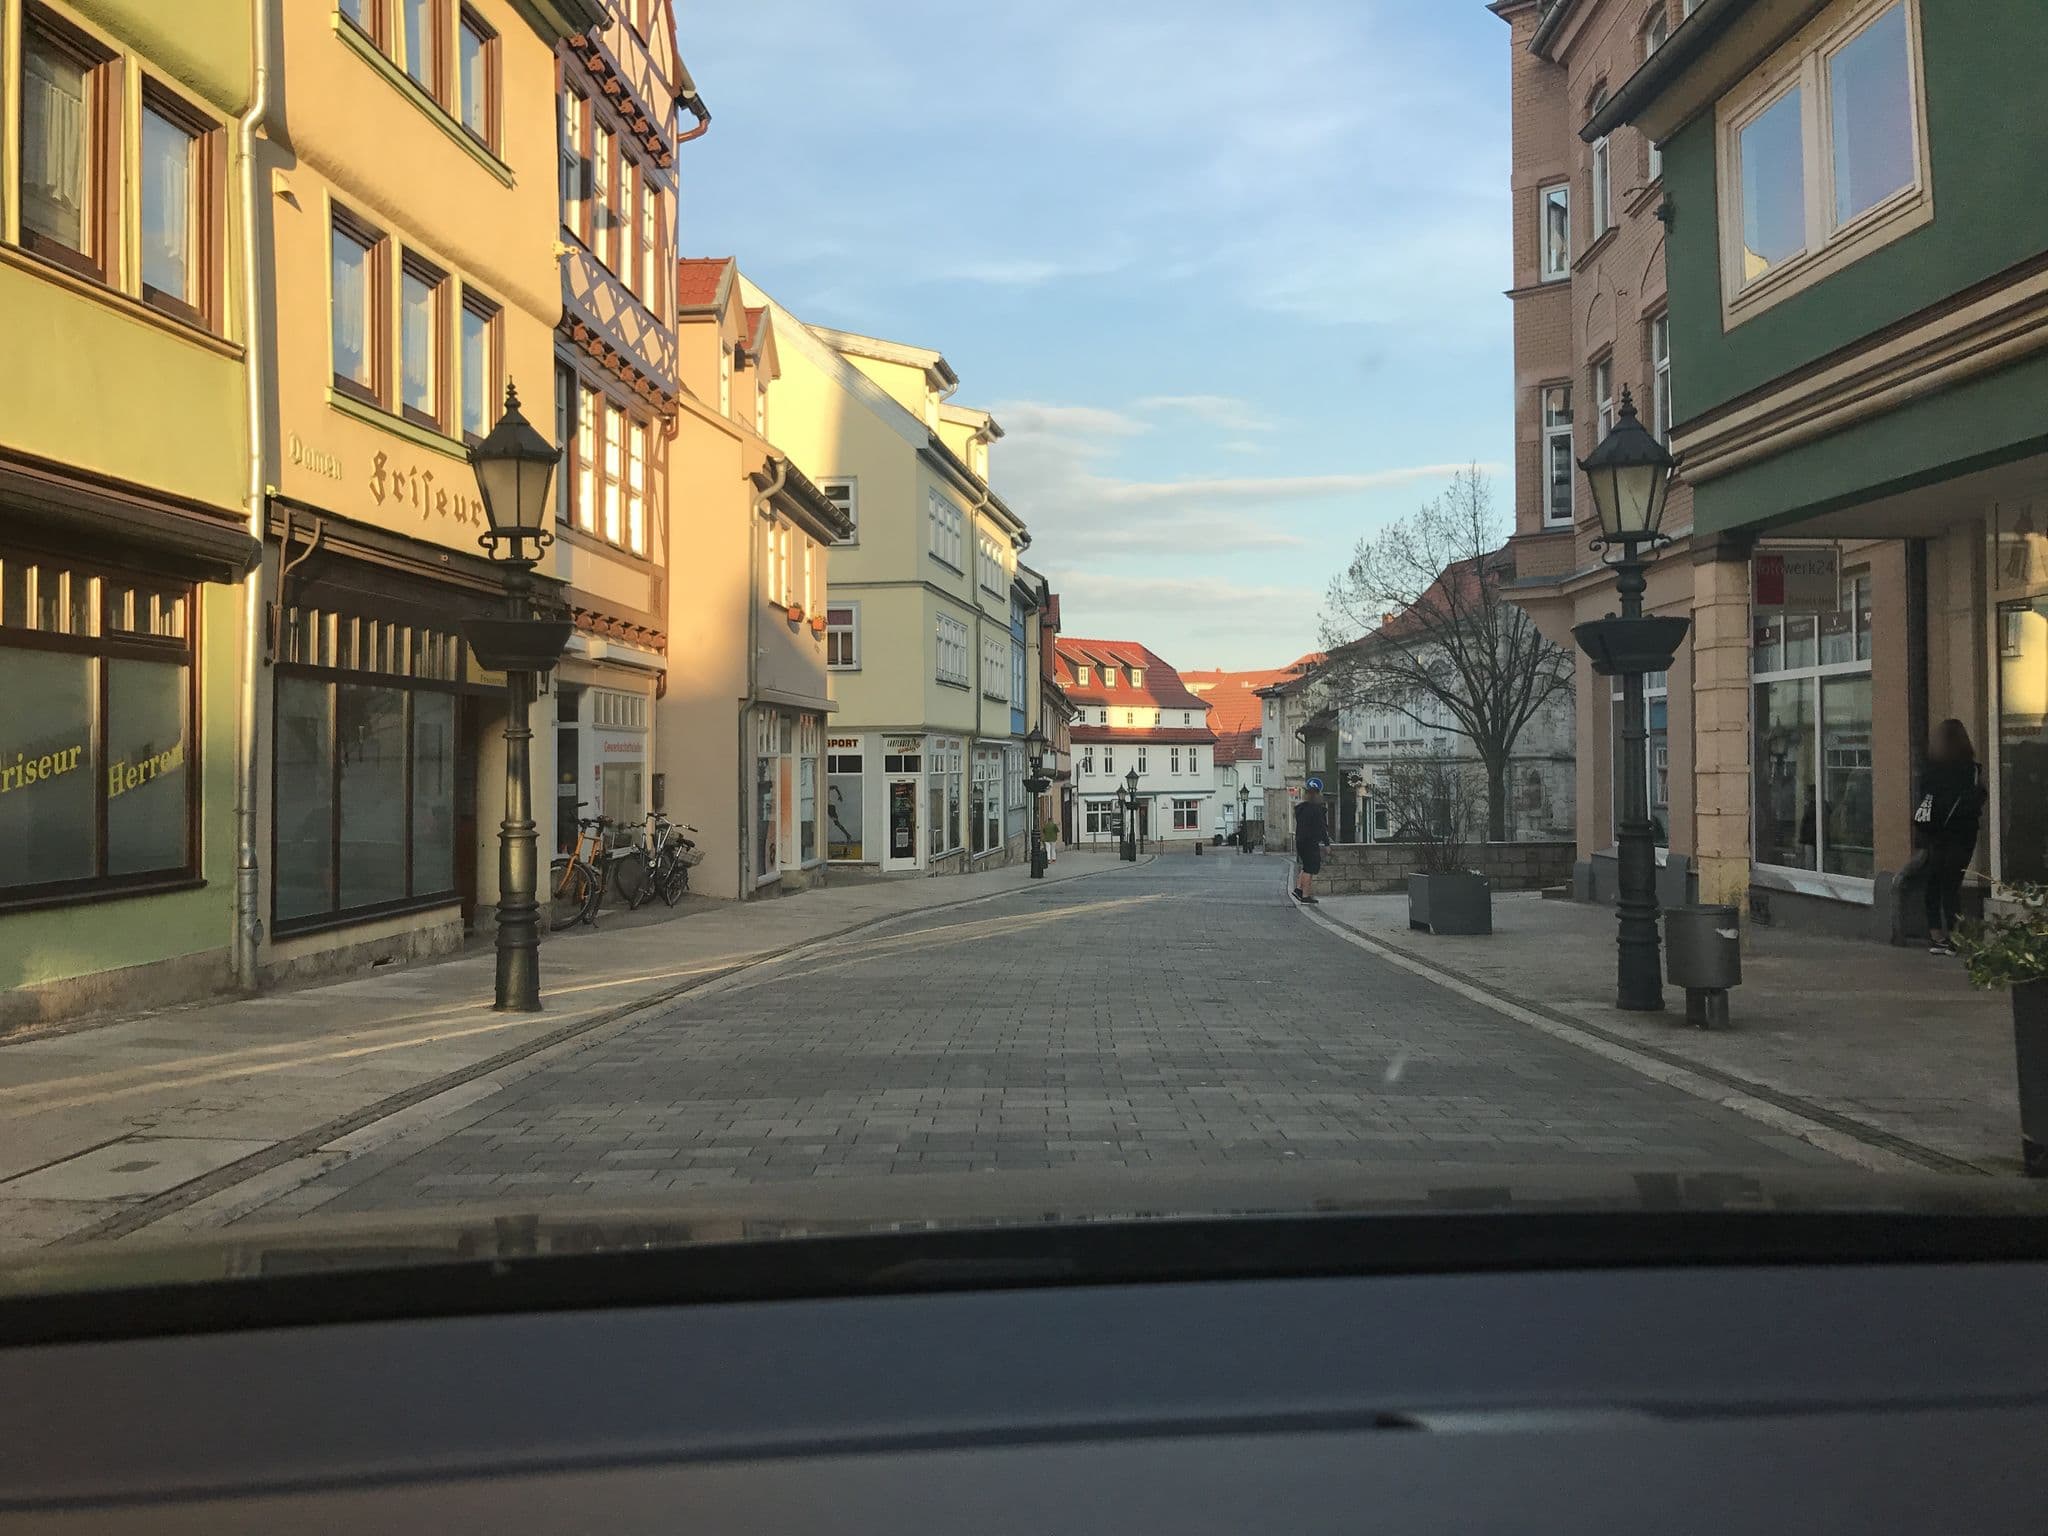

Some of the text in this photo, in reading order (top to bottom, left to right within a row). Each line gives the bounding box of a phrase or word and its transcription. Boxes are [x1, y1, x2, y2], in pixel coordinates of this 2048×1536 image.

[288, 431, 343, 481] Damen
[0, 741, 185, 798] riseur Herren
